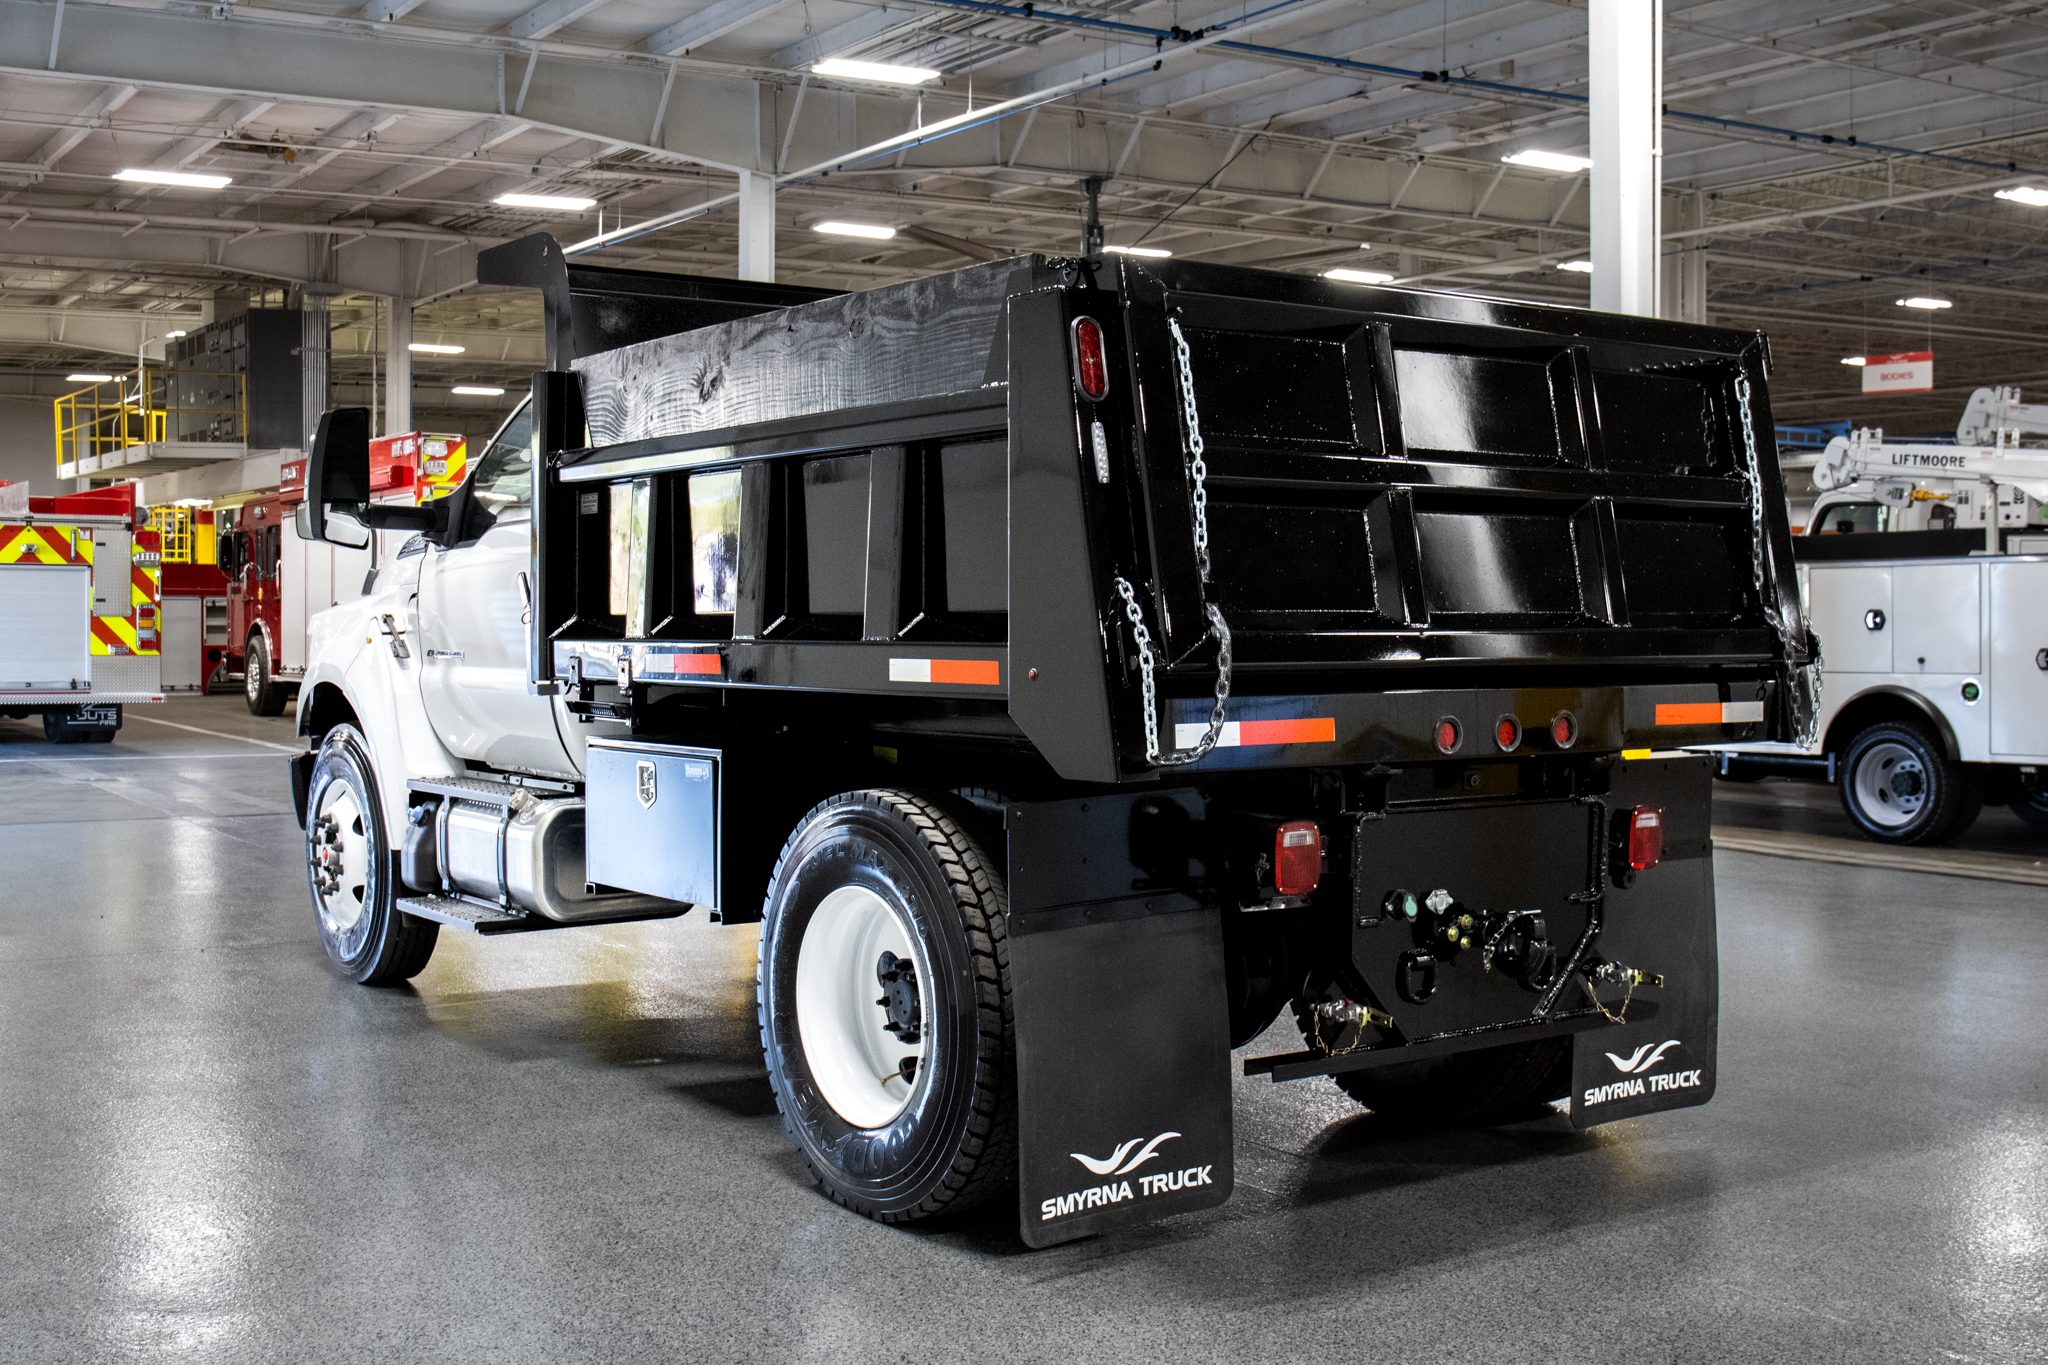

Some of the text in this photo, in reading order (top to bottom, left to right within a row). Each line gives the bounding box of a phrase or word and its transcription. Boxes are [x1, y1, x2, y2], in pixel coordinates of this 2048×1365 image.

[1880, 371, 1913, 381] BODIES
[1891, 453, 1967, 468] LIFTMOORE
[67, 710, 117, 720] OUTS
[801, 842, 845, 881] FUEL
[852, 842, 893, 877] MAX
[1584, 1069, 1701, 1107] SMYRNA TRUCK
[1041, 1164, 1213, 1221] SMYRNA TRUCK
